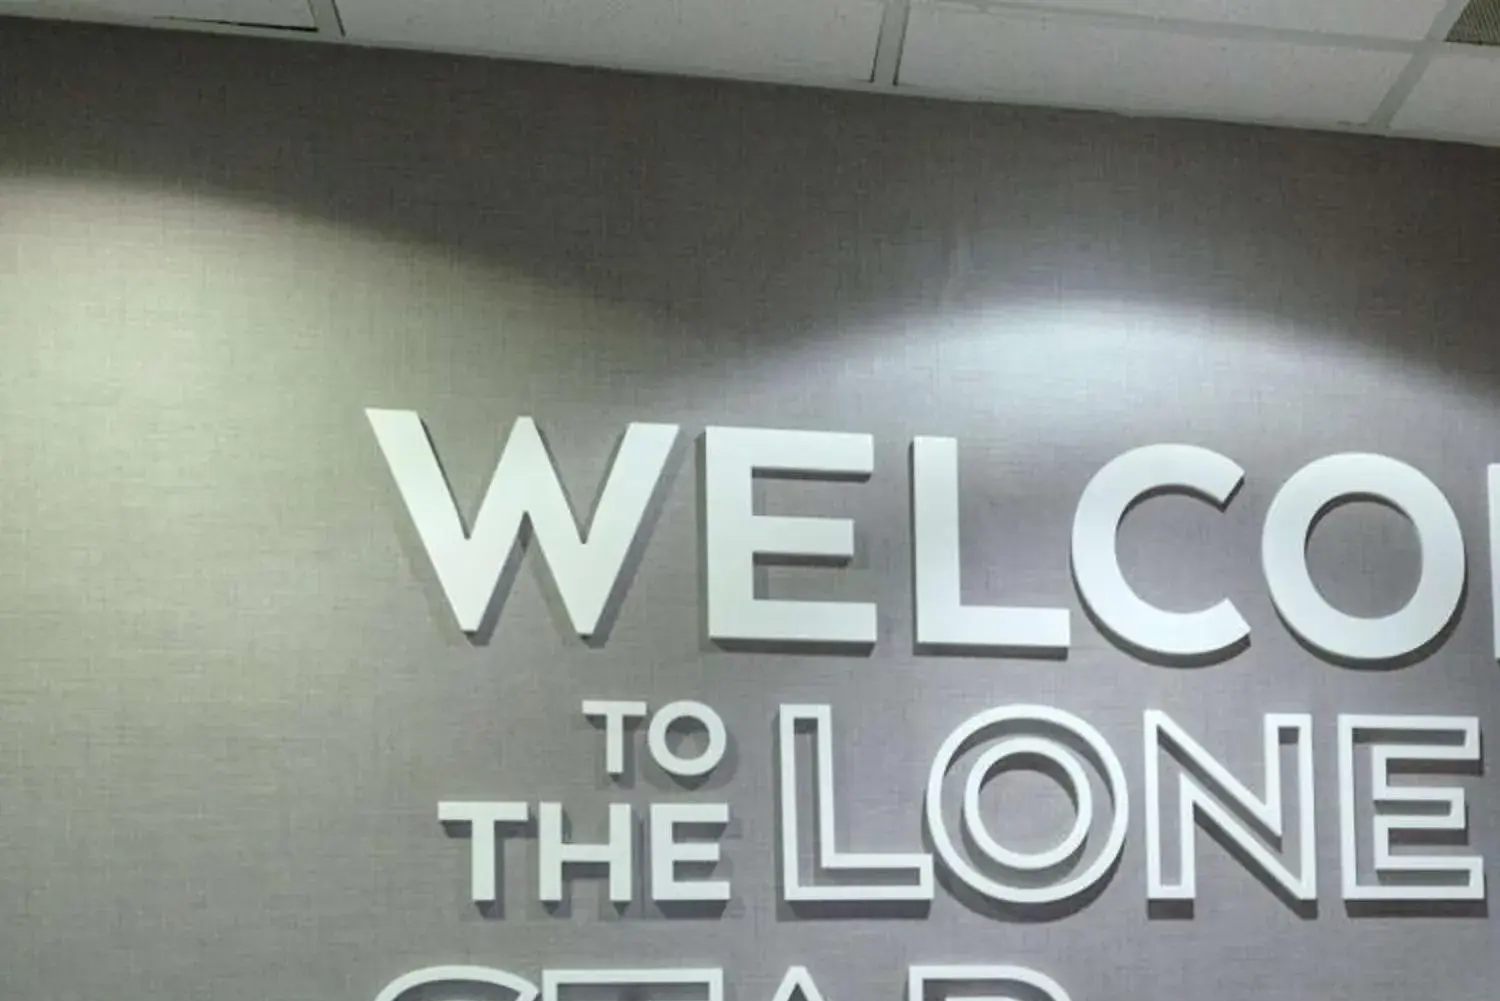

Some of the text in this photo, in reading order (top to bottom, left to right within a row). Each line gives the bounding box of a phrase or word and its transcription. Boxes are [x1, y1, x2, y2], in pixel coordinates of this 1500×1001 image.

[438, 702, 1486, 905] THE LONE
[582, 699, 728, 778] TO
